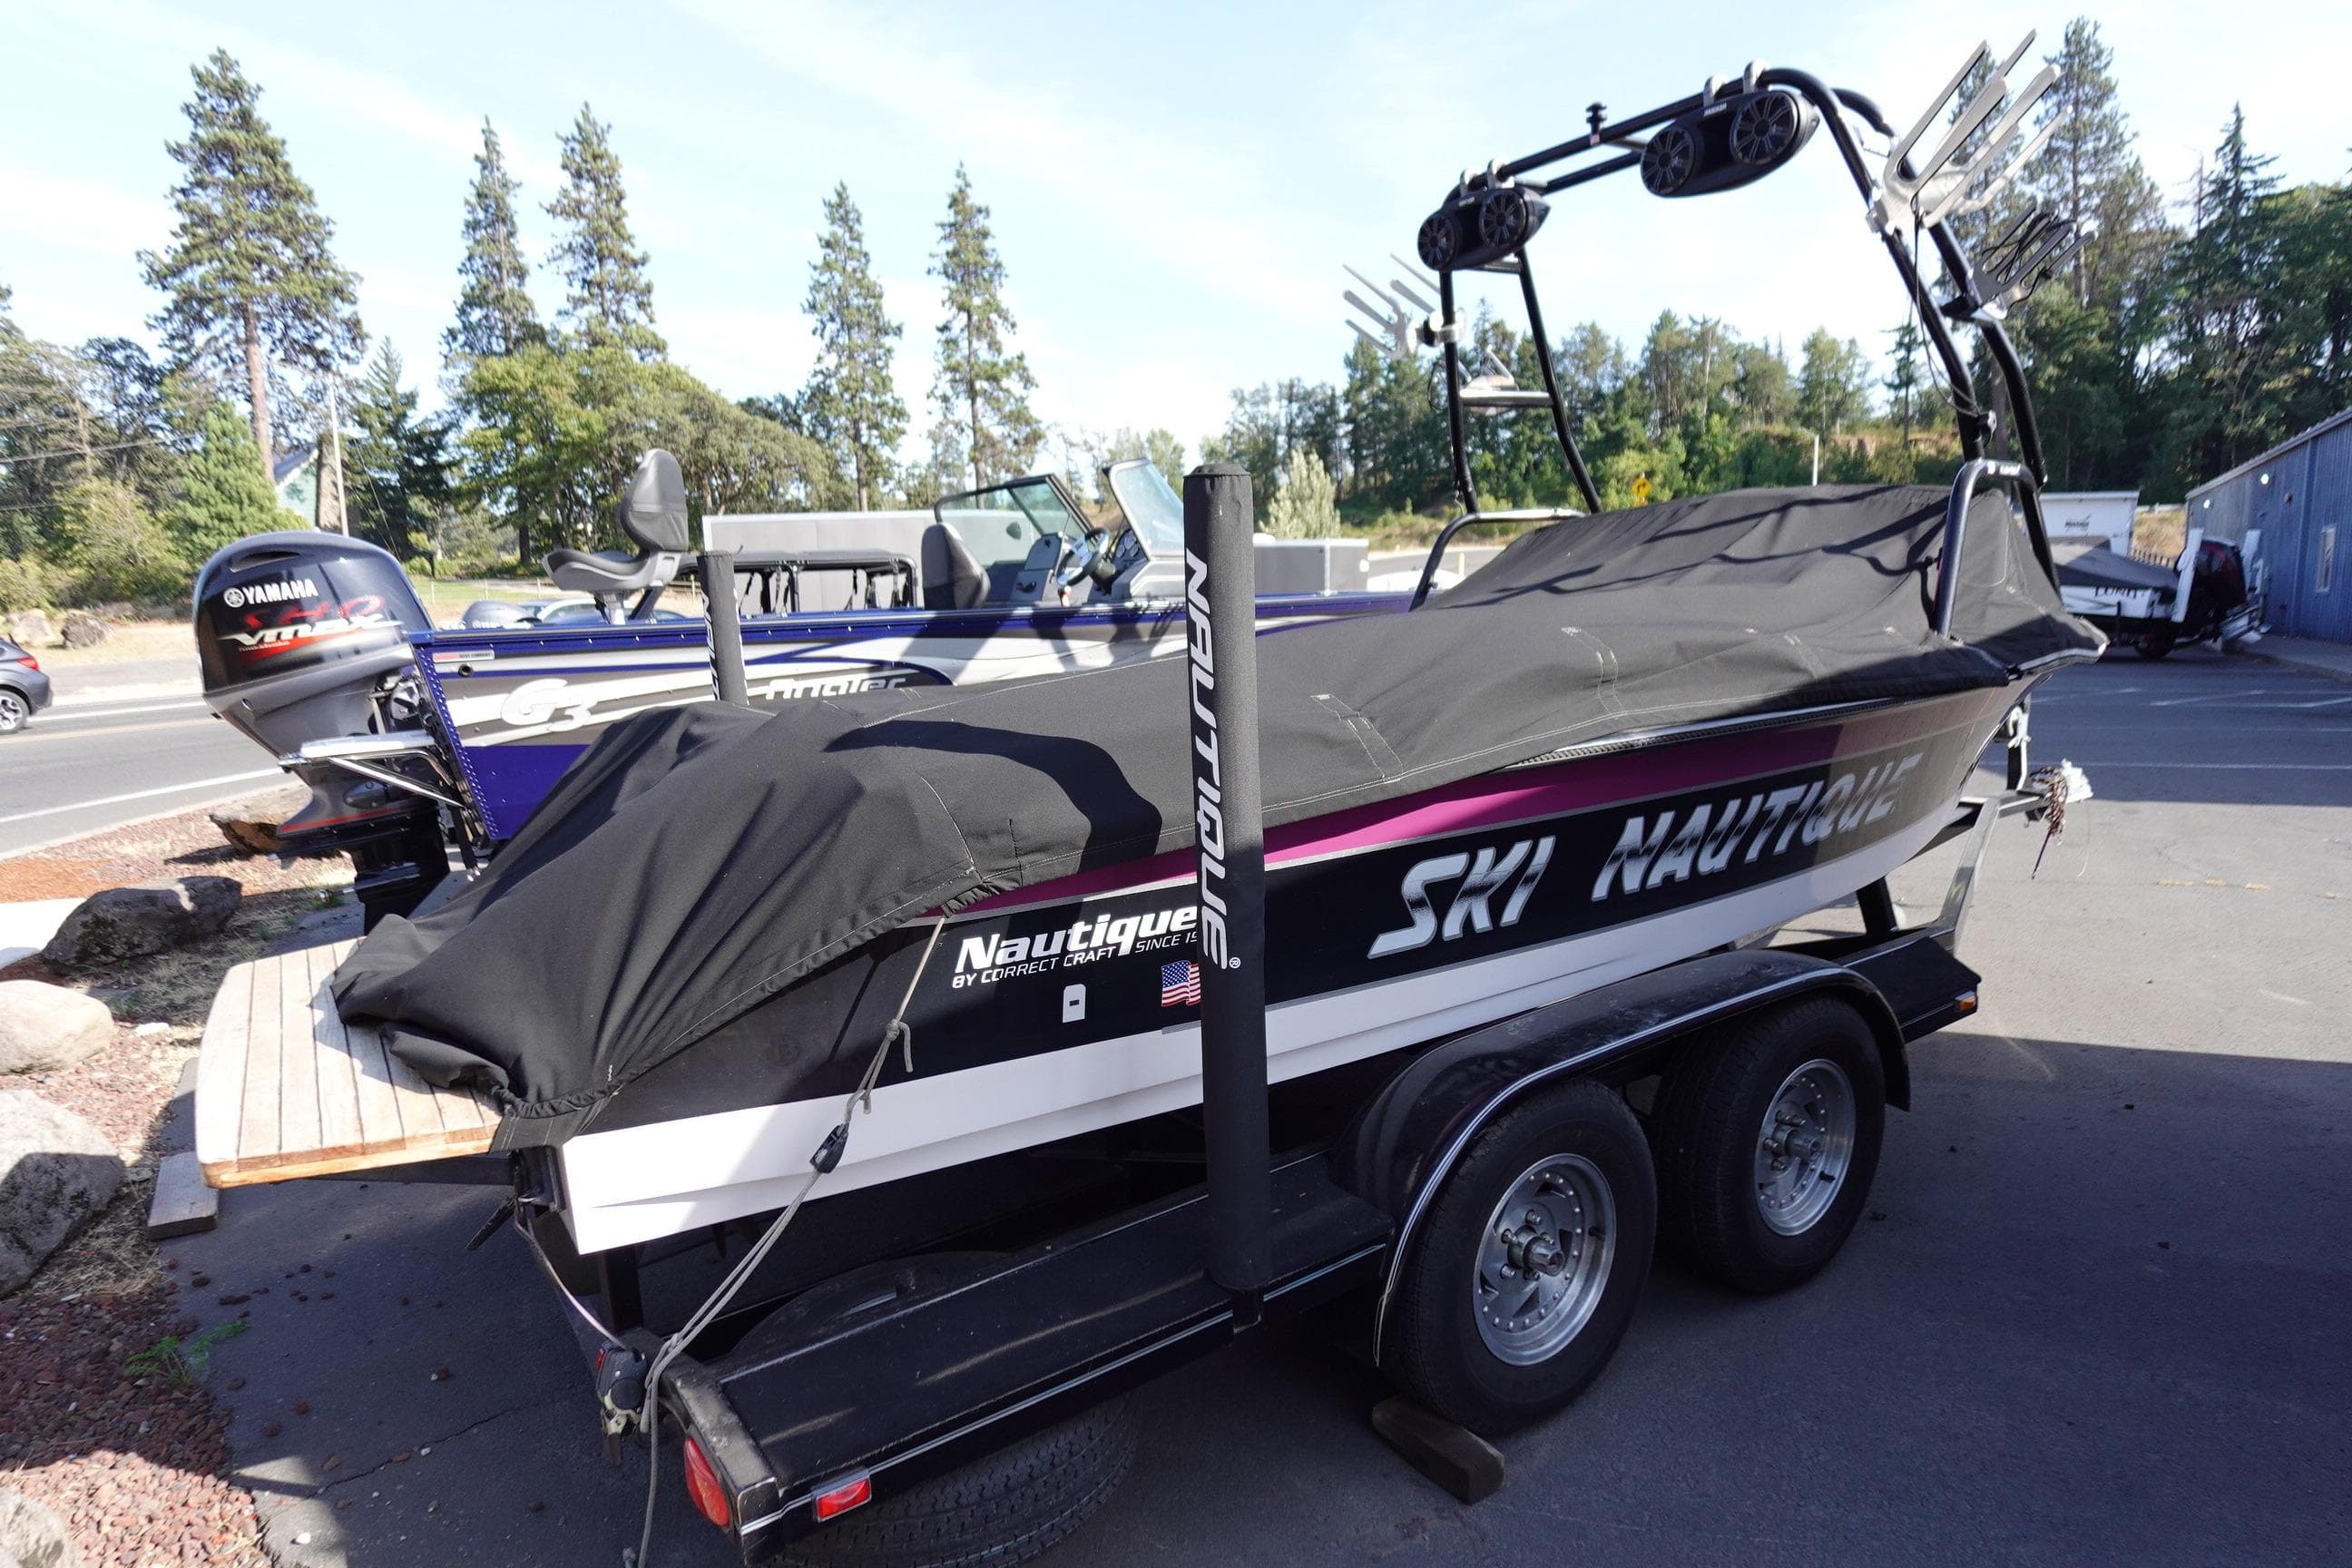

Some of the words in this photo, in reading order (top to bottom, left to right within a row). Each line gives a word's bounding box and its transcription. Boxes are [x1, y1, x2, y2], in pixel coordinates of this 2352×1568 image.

[242, 578, 318, 604] YAMAHA
[501, 678, 598, 732] G3
[1186, 548, 1228, 969] NAUTIQUE
[1367, 835, 1555, 959] SKI
[1591, 752, 1924, 903] NAUTIQUE
[953, 974, 977, 988] BY
[981, 957, 1060, 983] CORRECT
[1063, 946, 1118, 967] CRAFT
[1135, 934, 1181, 954] SINCE
[955, 906, 1198, 974] Nautique
